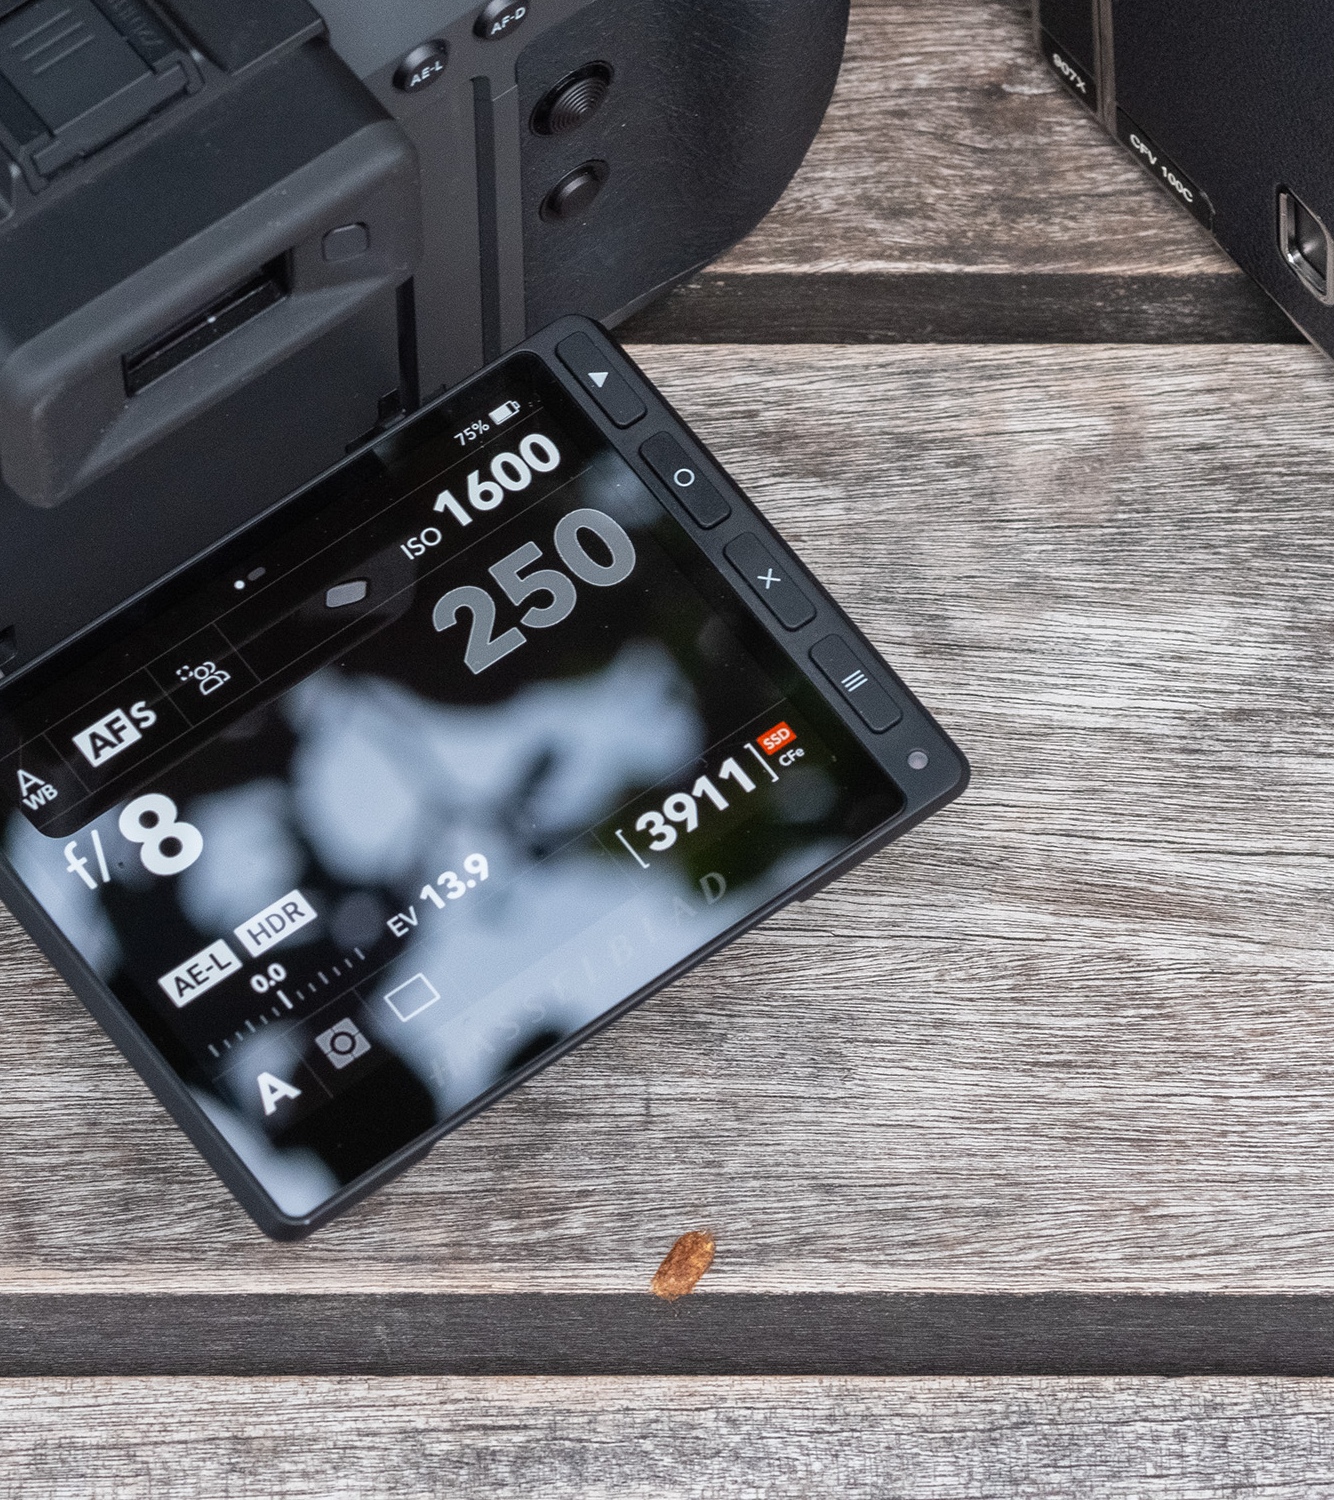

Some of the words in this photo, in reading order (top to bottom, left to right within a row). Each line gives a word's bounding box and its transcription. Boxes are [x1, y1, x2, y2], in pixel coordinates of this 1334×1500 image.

[491, 7, 526, 35] AF-D
[410, 61, 443, 87] AE-L
[1052, 53, 1087, 94] 907X
[1130, 133, 1157, 165] CFV
[1161, 166, 1194, 203] 100C
[453, 419, 490, 446] 75%
[400, 527, 442, 560] ISO
[433, 433, 561, 527] 1600
[432, 508, 637, 675] 250
[761, 726, 793, 752] SSD
[778, 747, 805, 767] CFe
[386, 905, 419, 938] EV
[419, 852, 489, 910] 13.9
[244, 898, 308, 949] HDR
[170, 950, 234, 1000] AE-L
[249, 962, 288, 994] 0.0
[257, 1071, 302, 1116] A
